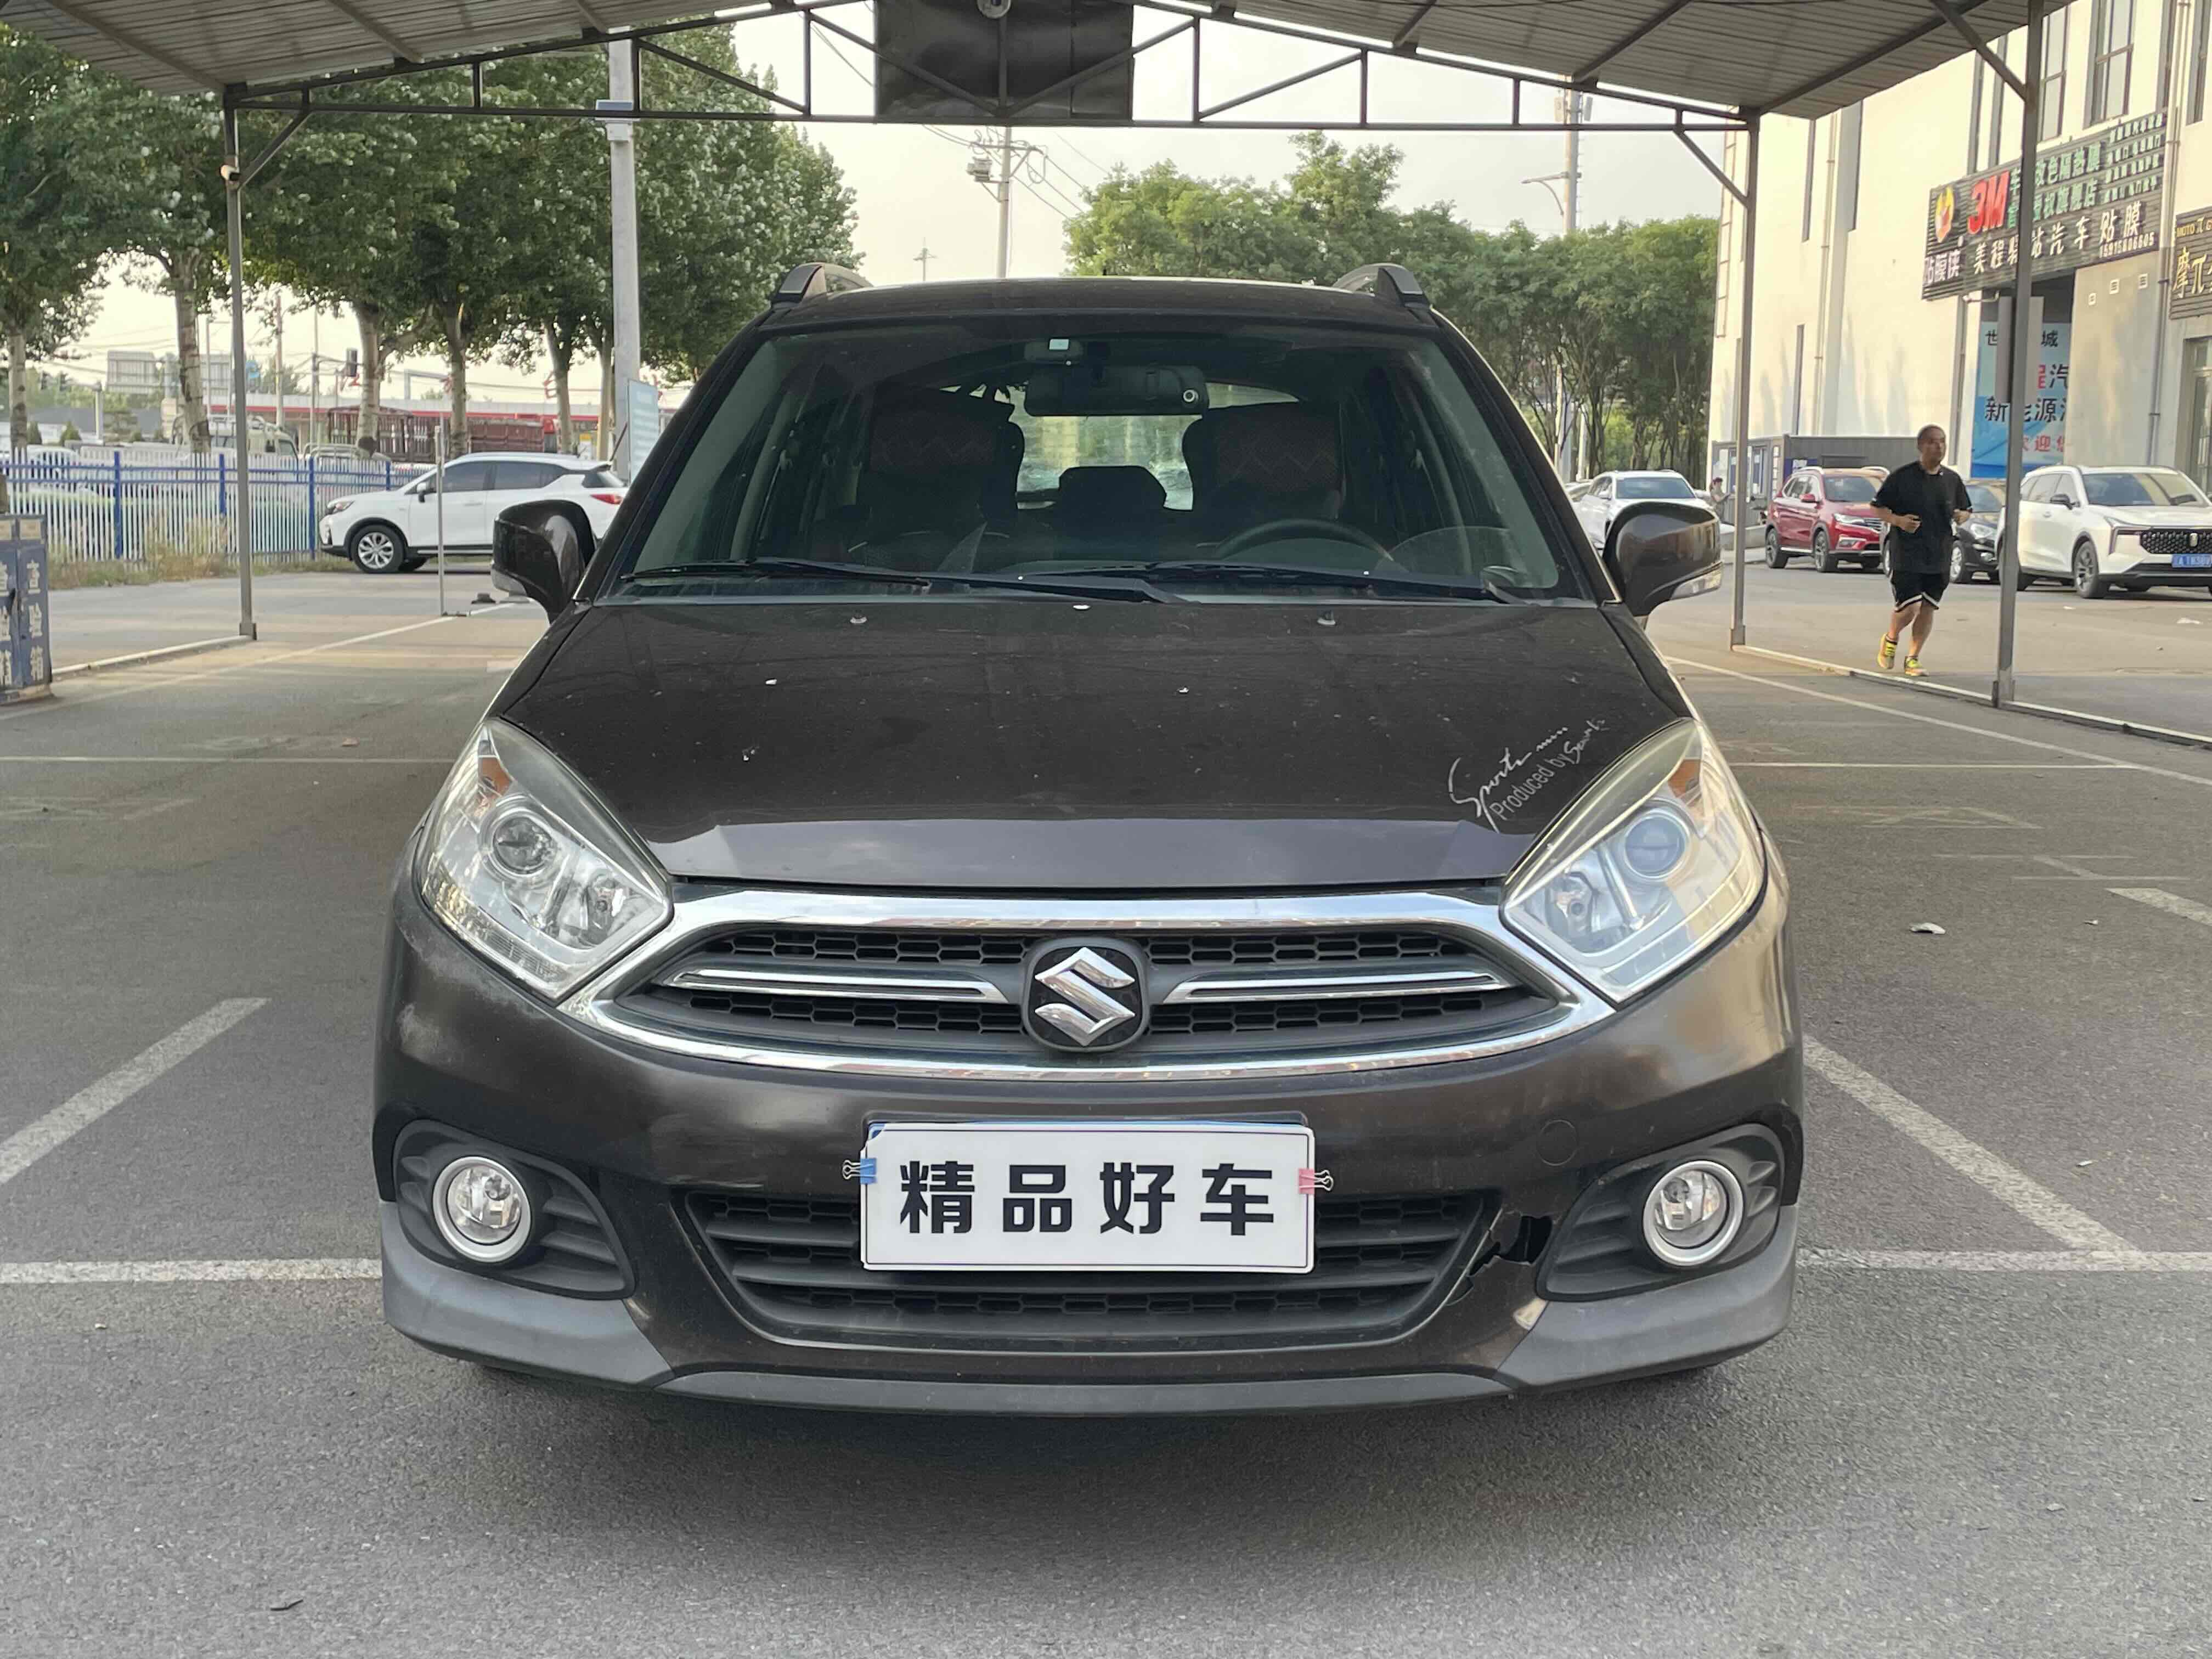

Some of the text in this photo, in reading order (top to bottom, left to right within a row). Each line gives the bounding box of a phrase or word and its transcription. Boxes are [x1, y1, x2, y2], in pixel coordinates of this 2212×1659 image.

[1967, 171, 2010, 234] 3M
[1489, 764, 1555, 821] Produced
[1544, 753, 1576, 768] by
[899, 1160, 1275, 1236] 精品好车
